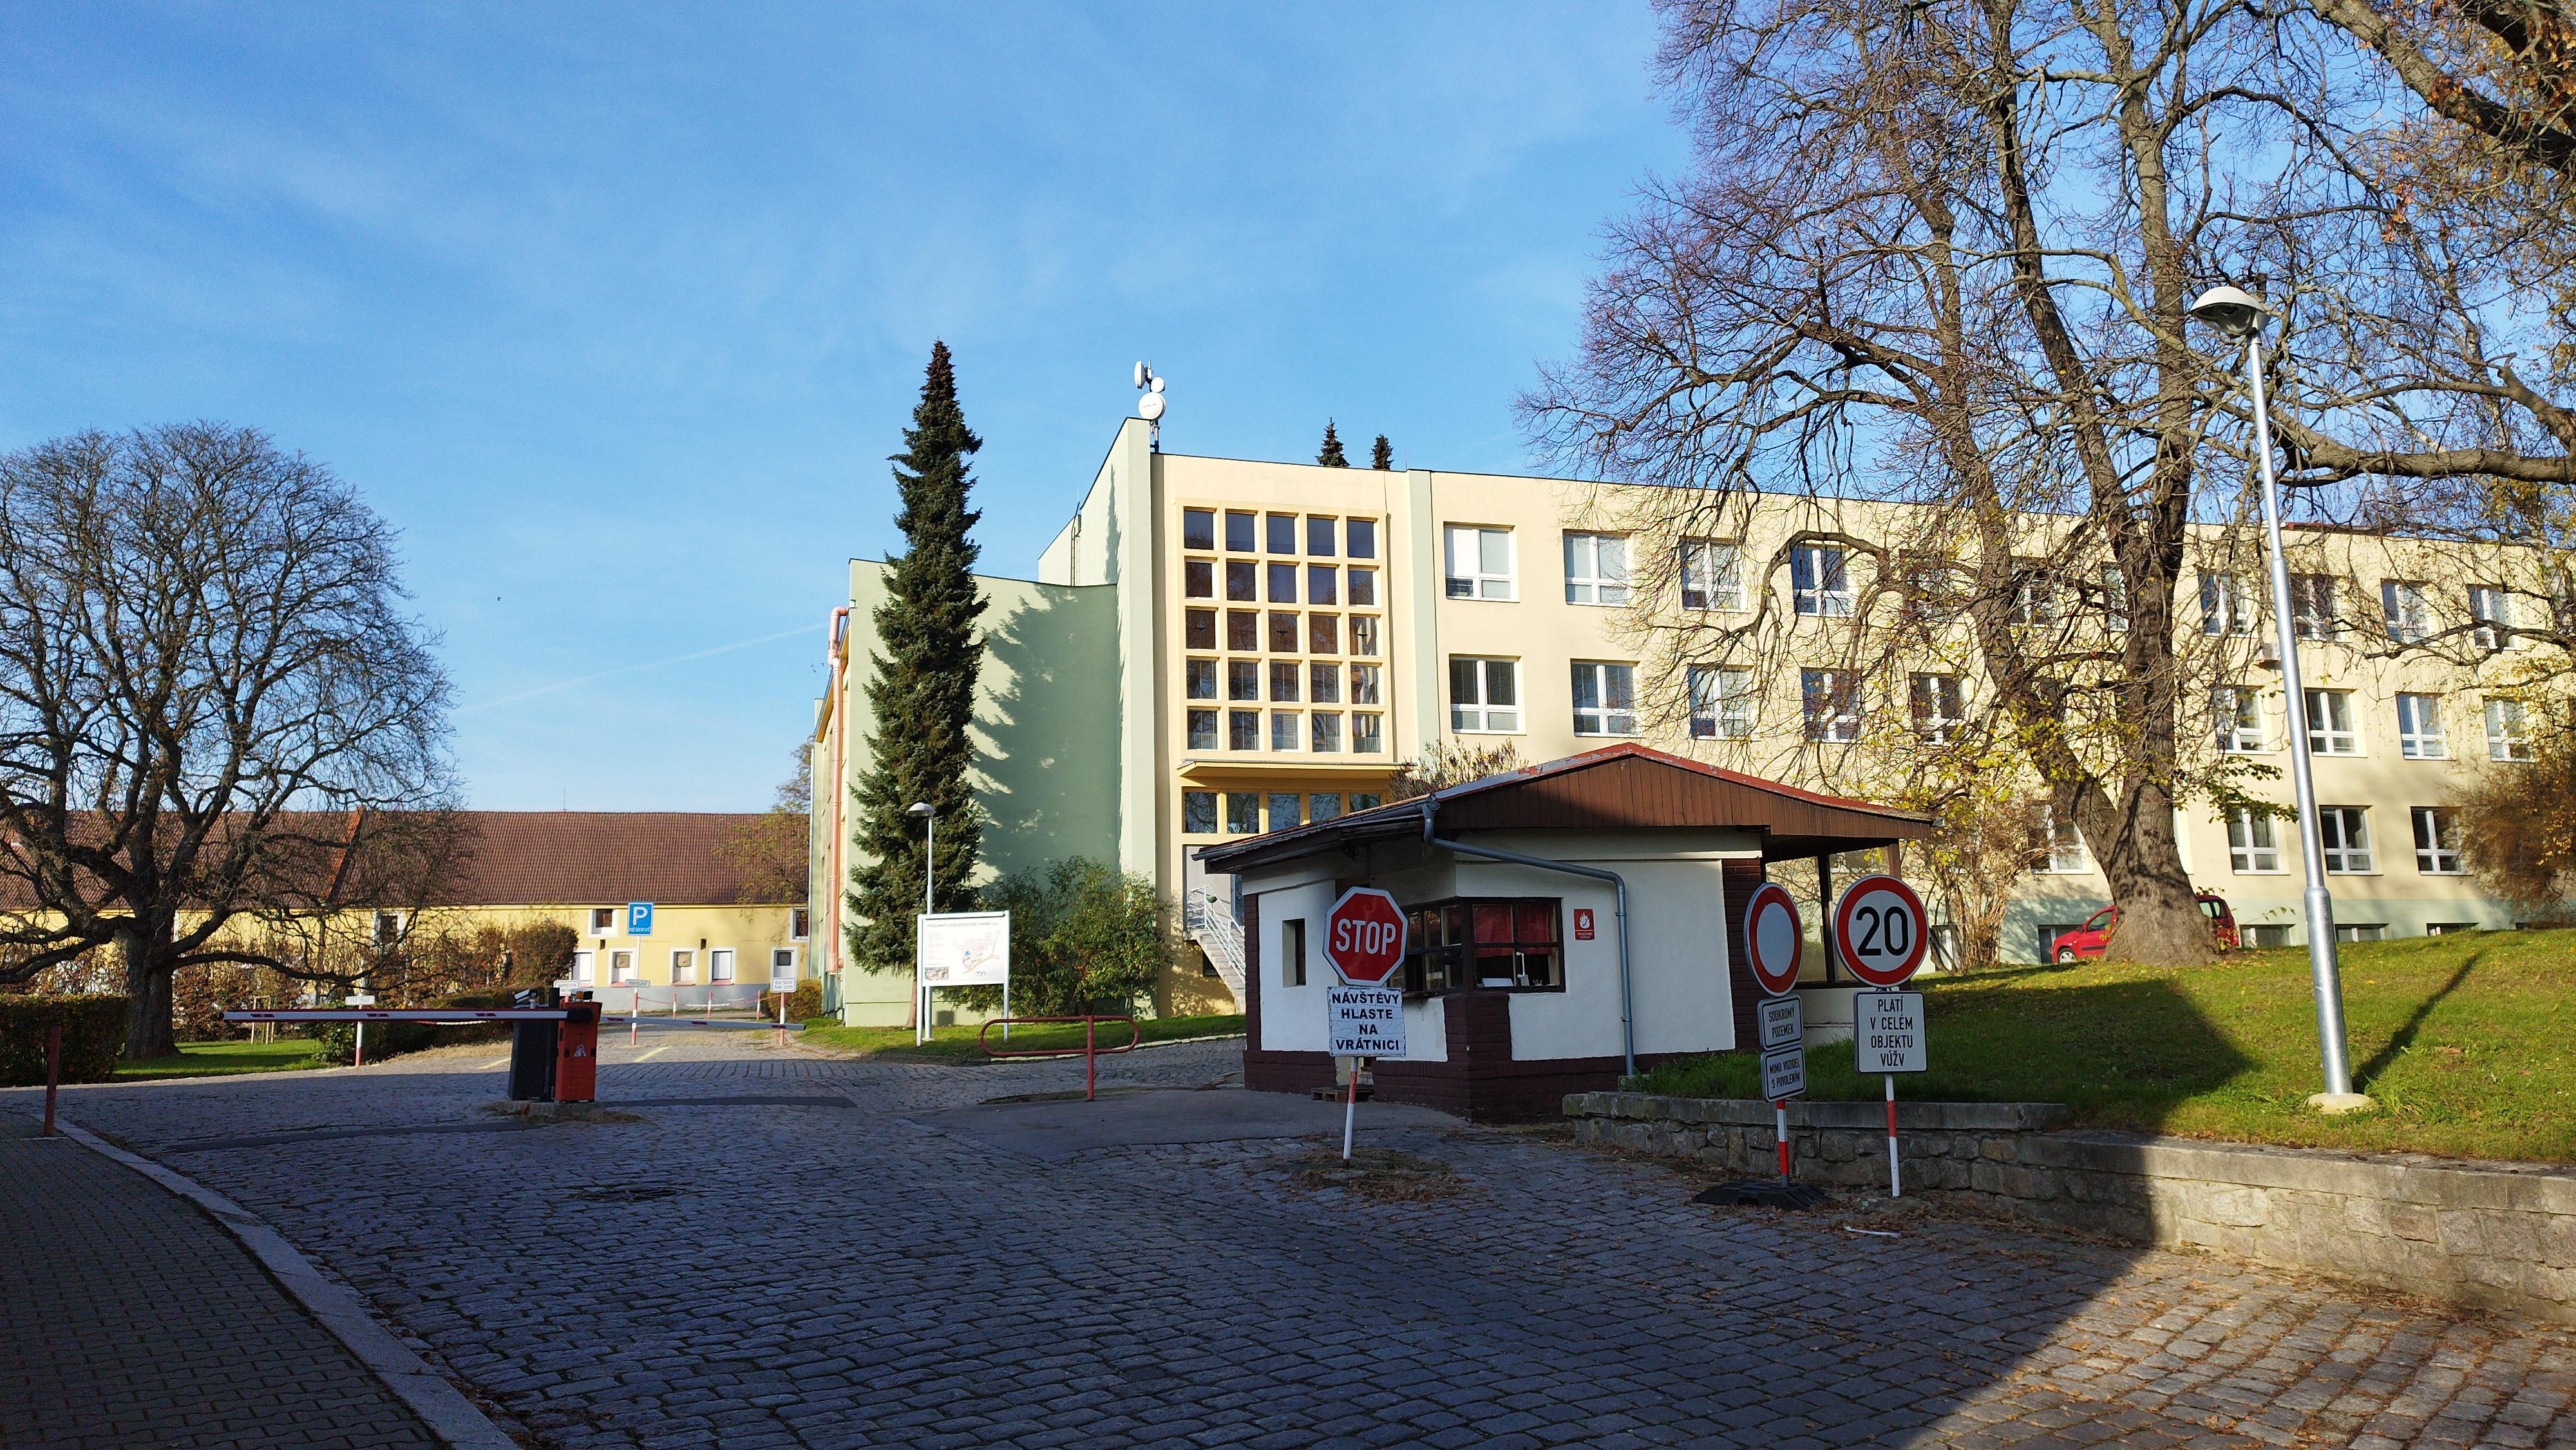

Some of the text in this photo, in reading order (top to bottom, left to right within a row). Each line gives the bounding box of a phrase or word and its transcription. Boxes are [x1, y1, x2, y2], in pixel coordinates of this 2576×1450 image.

[633, 907, 648, 925] P
[1336, 918, 1396, 956] STOP
[1855, 906, 1909, 957] 20
[1332, 991, 1399, 1004] NÁVŠTĚVY
[1877, 995, 1904, 1012] PLATÍ
[1341, 1008, 1394, 1019] HLASTE
[1870, 1013, 1913, 1030] V CELÉM
[1359, 1024, 1378, 1035] NA
[1772, 1022, 1795, 1039] POZEMEK
[1336, 1037, 1399, 1051] VRÁTNICI
[1870, 1035, 1913, 1048] OBJEKTU
[1880, 1050, 1905, 1067] VÚŽV
[1772, 1078, 1776, 1089] S
